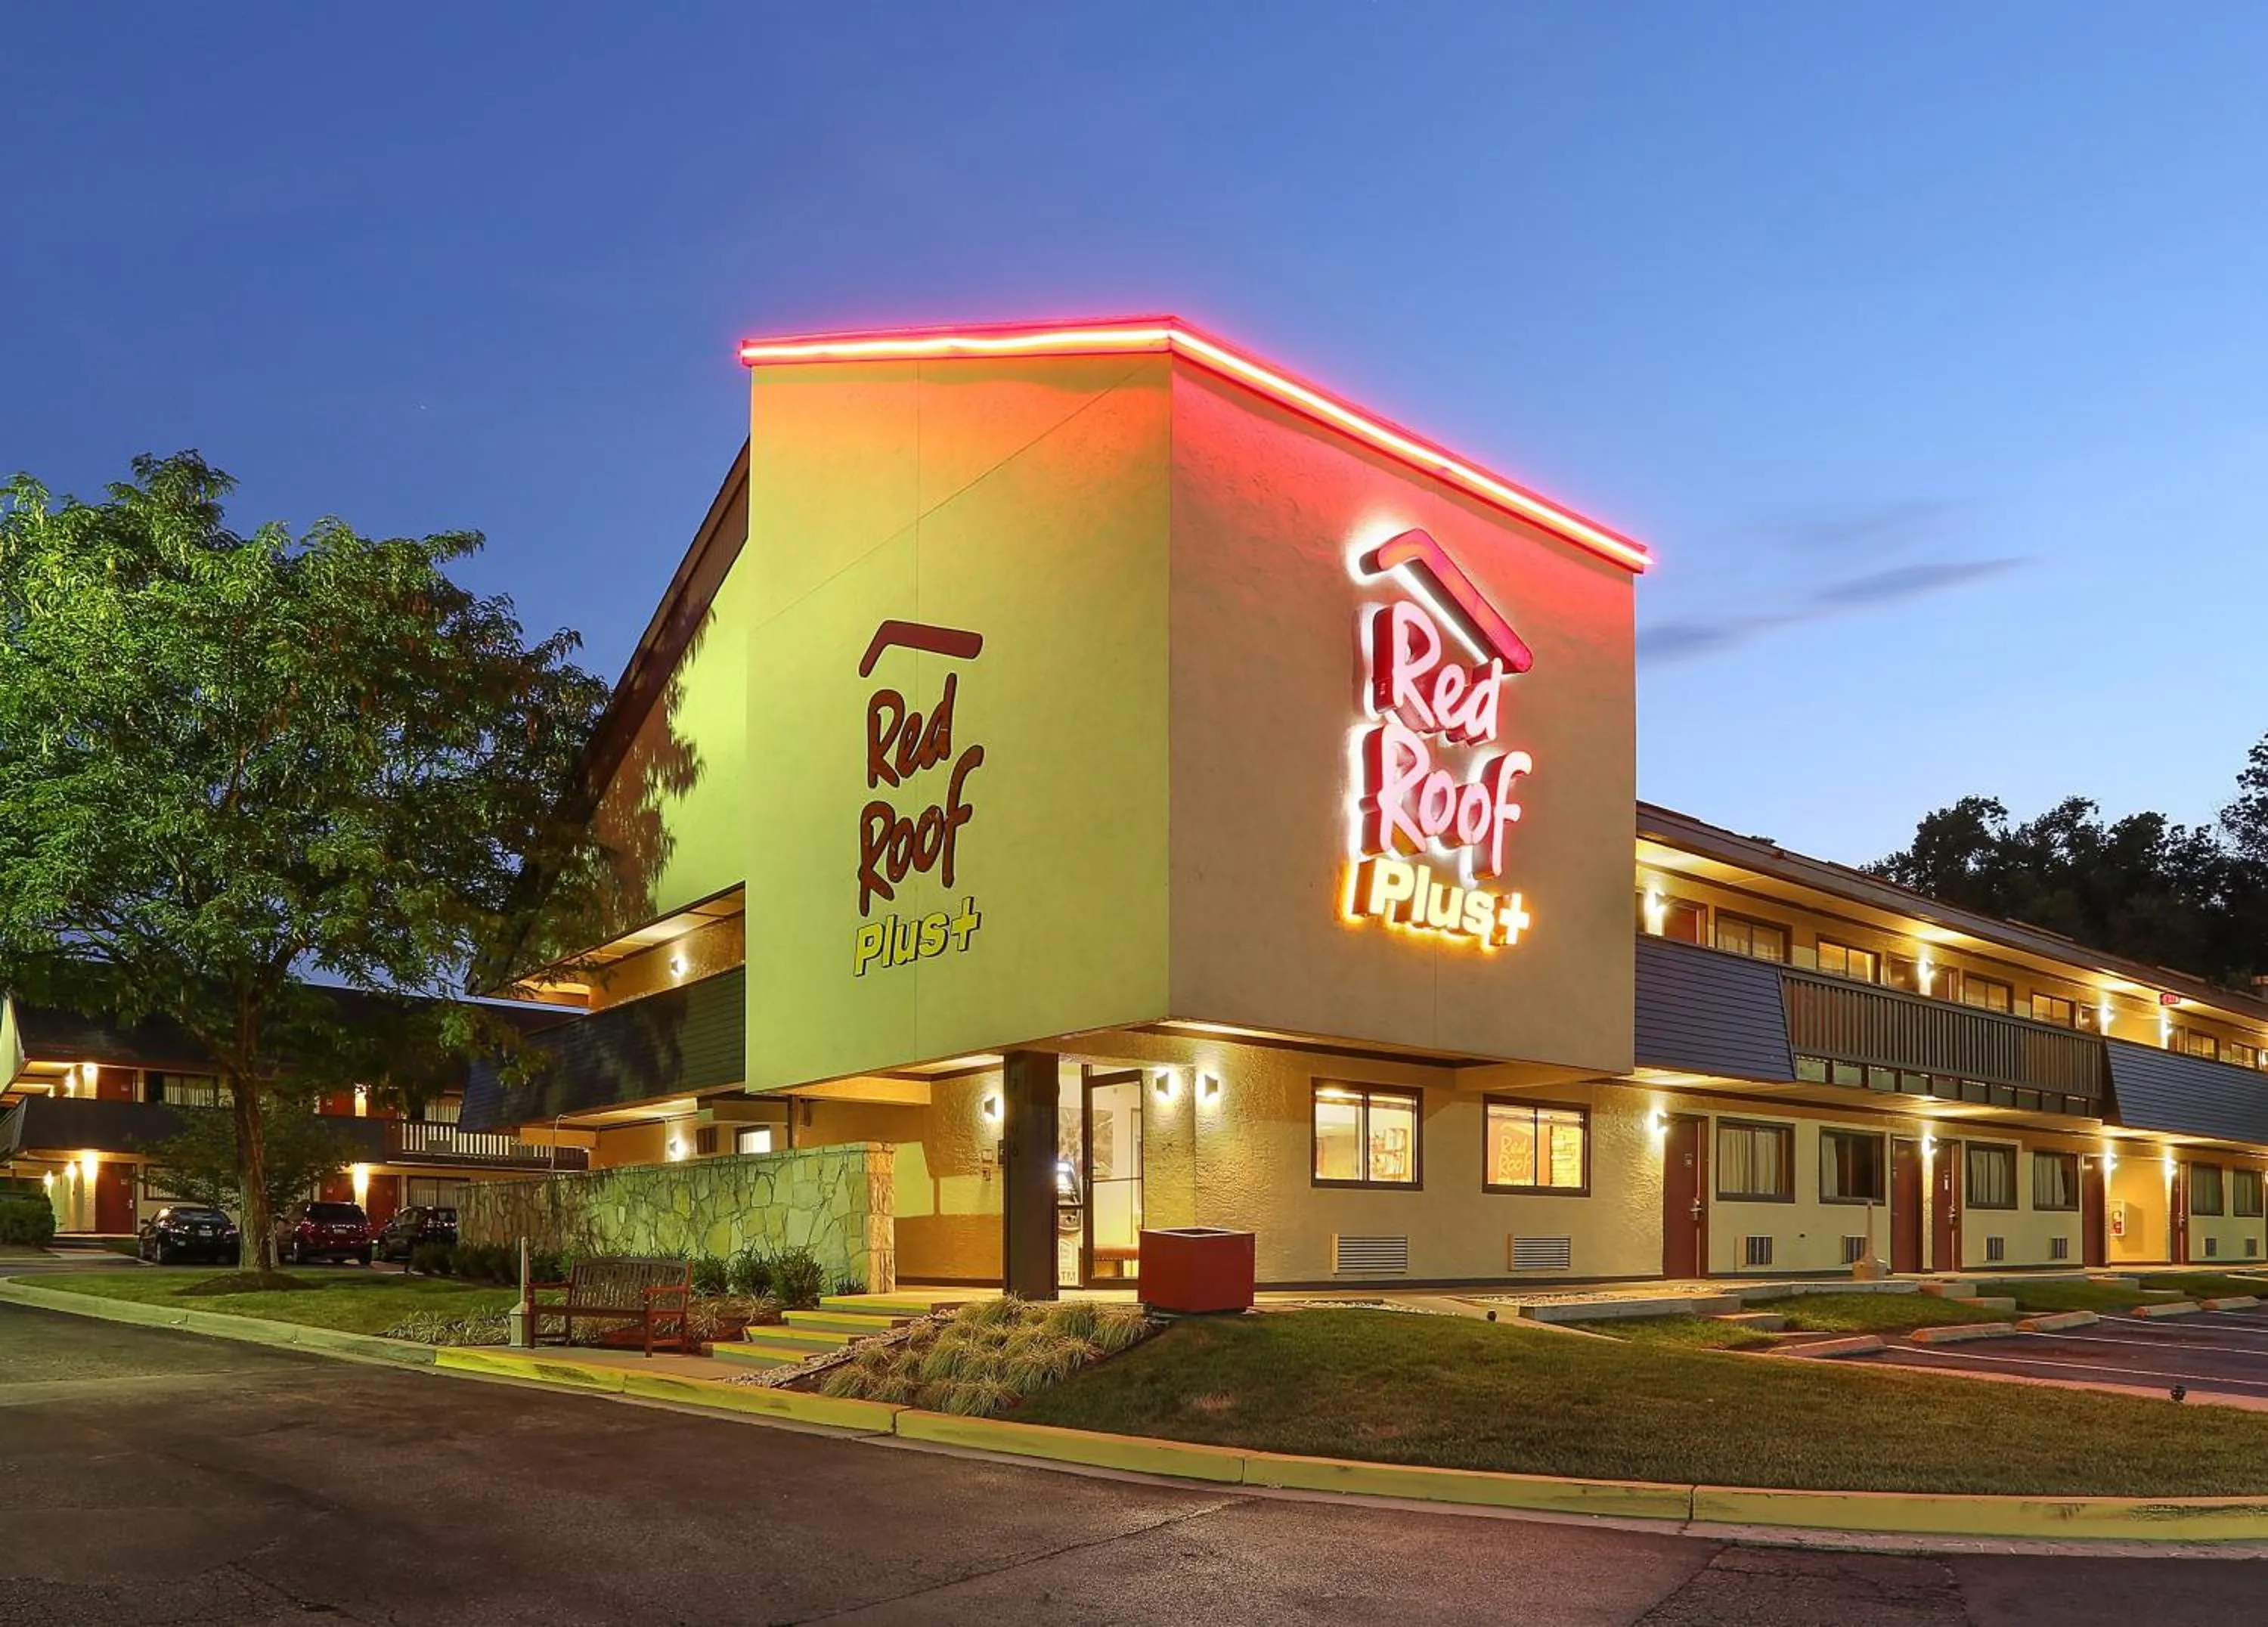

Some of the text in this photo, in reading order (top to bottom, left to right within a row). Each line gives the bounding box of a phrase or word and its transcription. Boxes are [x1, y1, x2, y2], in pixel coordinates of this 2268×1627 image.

[1392, 601, 1503, 741] Red
[867, 673, 958, 789] Red
[858, 745, 984, 917] Roof
[1377, 723, 1532, 877] Roof
[854, 896, 981, 977] Plus+
[1369, 857, 1530, 944] Plus+
[1058, 1271, 1076, 1283] TM
